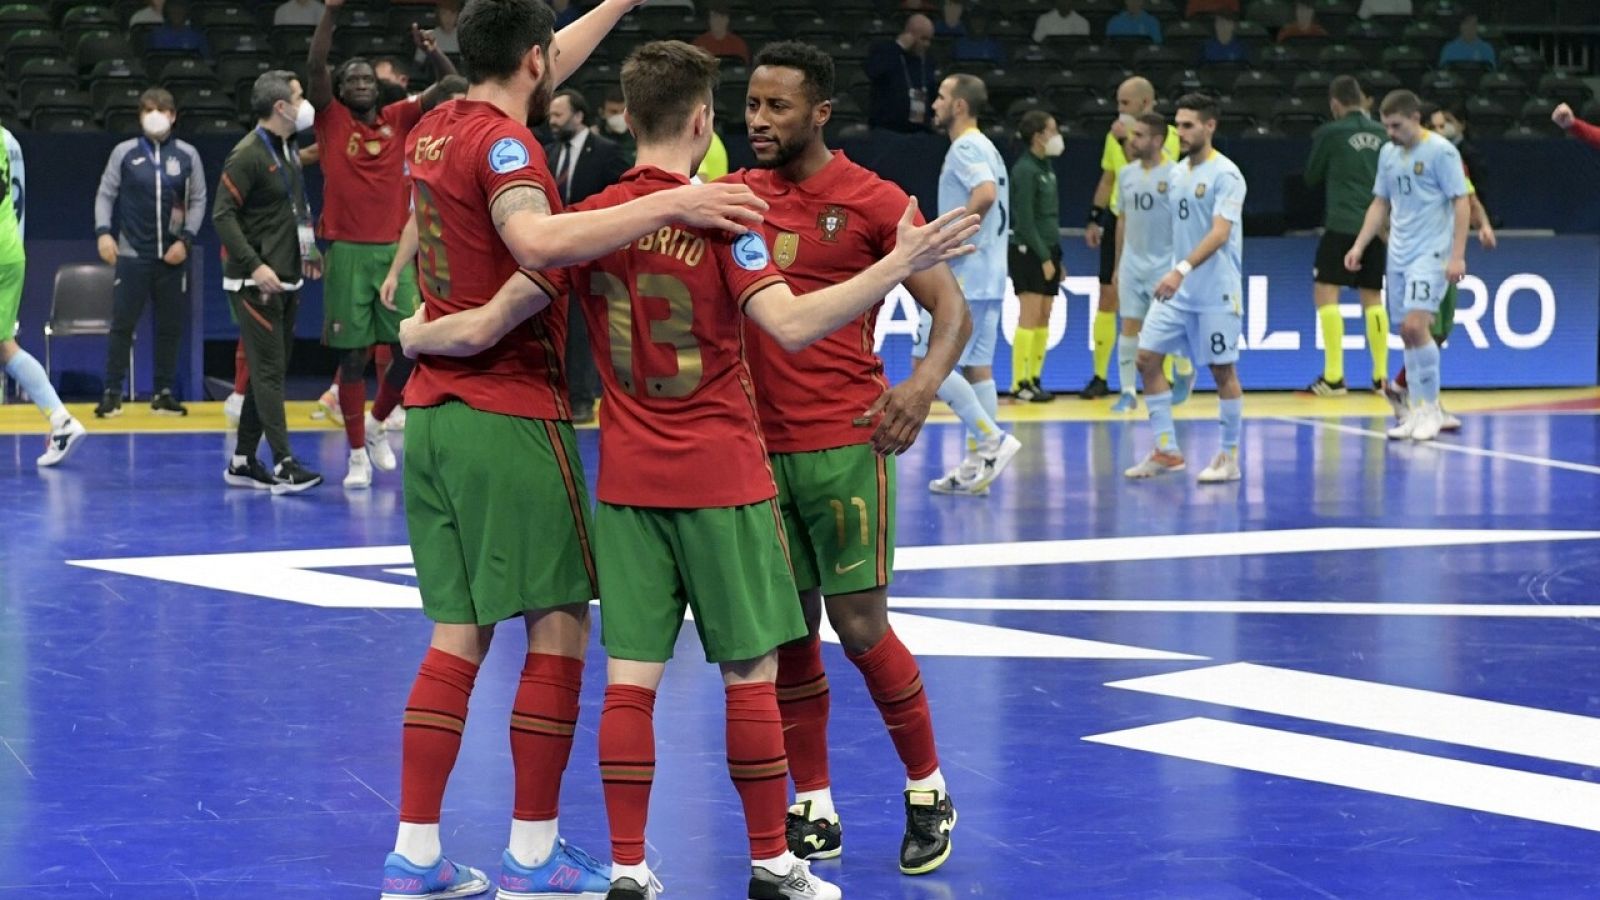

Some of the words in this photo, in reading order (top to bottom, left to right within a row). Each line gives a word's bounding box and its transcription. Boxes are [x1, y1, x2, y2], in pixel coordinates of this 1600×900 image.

[346, 132, 362, 156] 6
[1396, 175, 1412, 195] 13
[1134, 192, 1154, 211] 10
[1178, 198, 1190, 220] 8
[638, 226, 705, 266] BRITO
[1410, 281, 1432, 301] 13
[590, 271, 704, 397] 13
[1210, 332, 1226, 355] 8
[830, 497, 869, 549] 11
